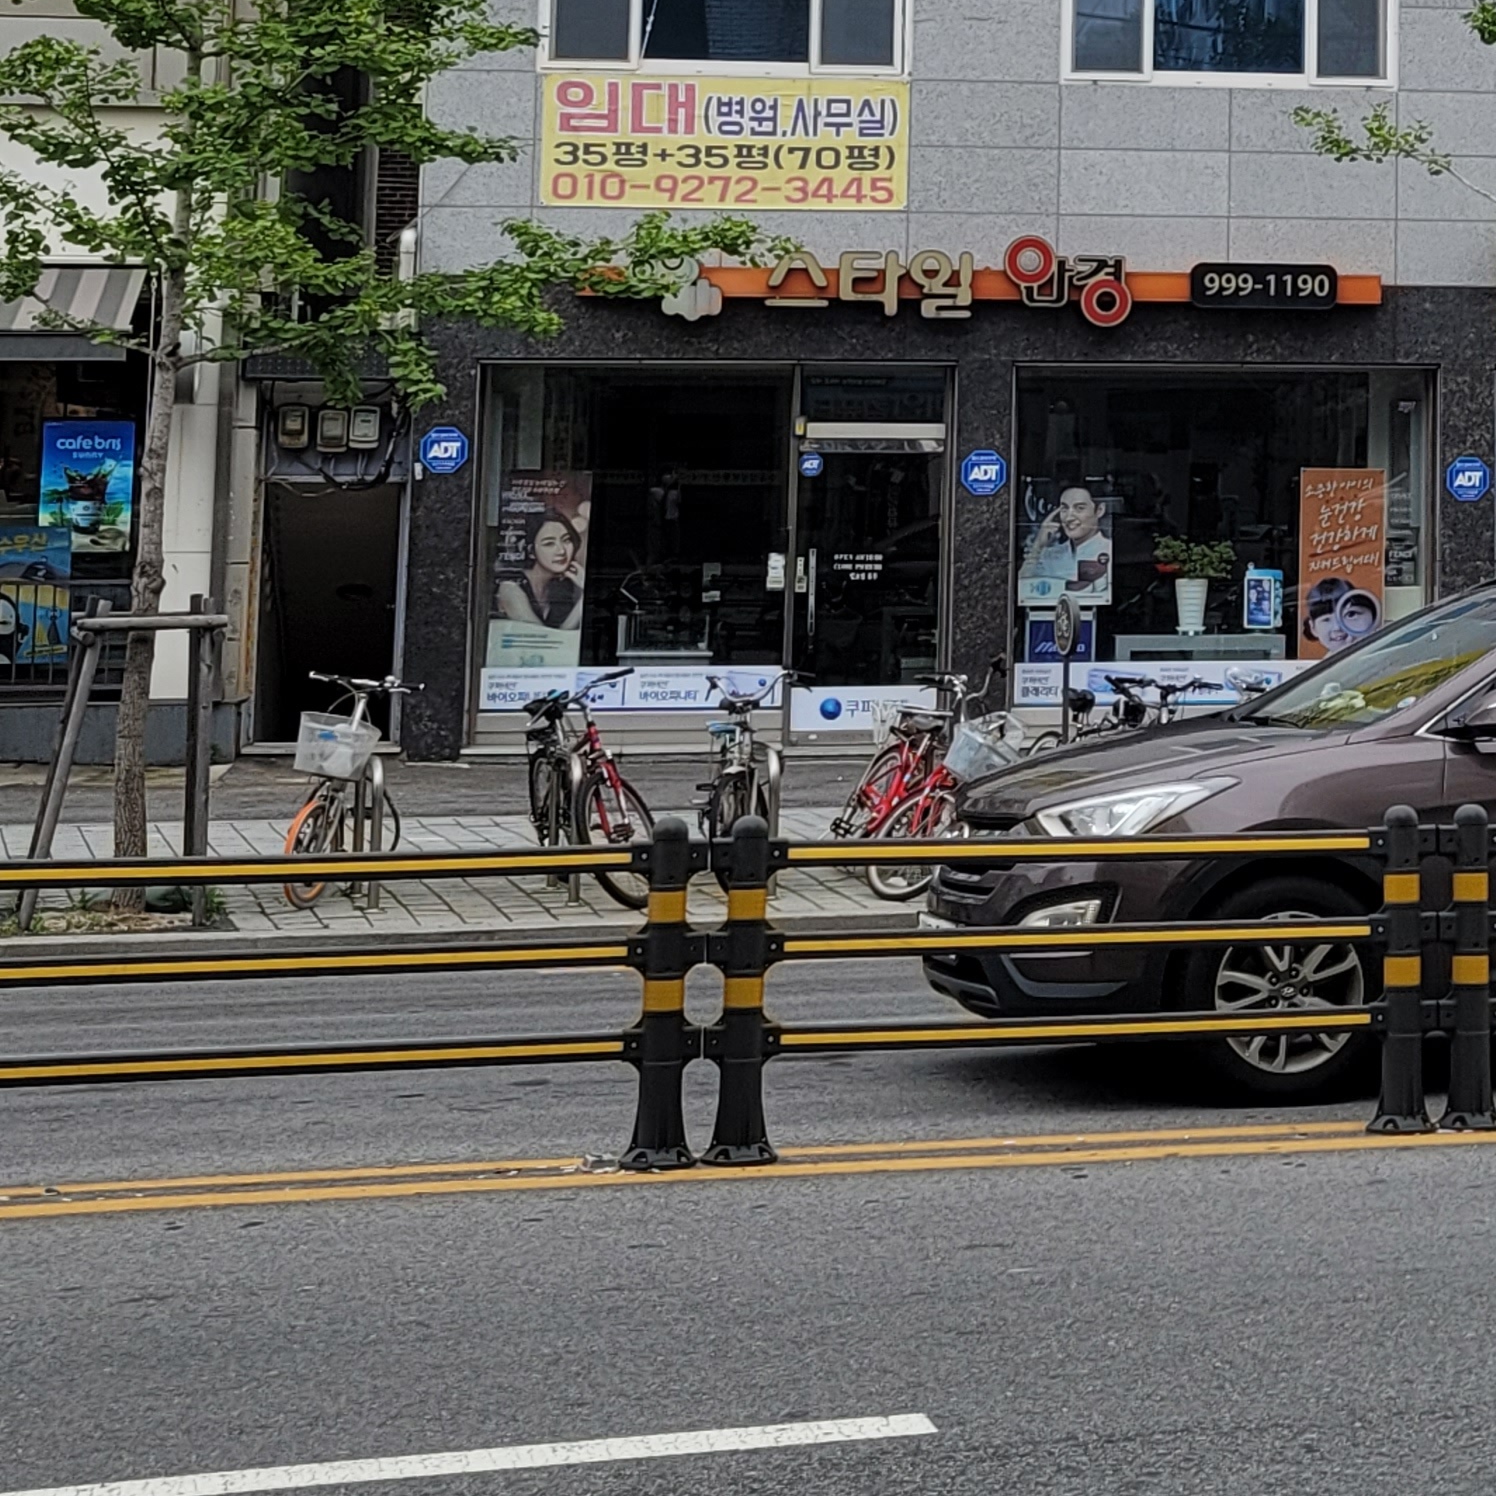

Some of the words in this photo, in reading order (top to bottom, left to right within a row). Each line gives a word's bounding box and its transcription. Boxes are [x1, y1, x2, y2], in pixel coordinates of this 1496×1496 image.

[555, 80, 698, 136] 임대
[703, 95, 898, 138] (병원,사무실)
[553, 141, 896, 172] 35평+35평(70평)
[551, 171, 895, 205] 010-9272-3445
[764, 248, 974, 319] 스타일
[1005, 234, 1132, 327] 안경
[1202, 272, 1331, 298] 999-1190
[56, 435, 93, 450] cafe
[427, 441, 461, 459] ADT
[968, 464, 999, 481] ADT
[1453, 470, 1484, 488] ADT
